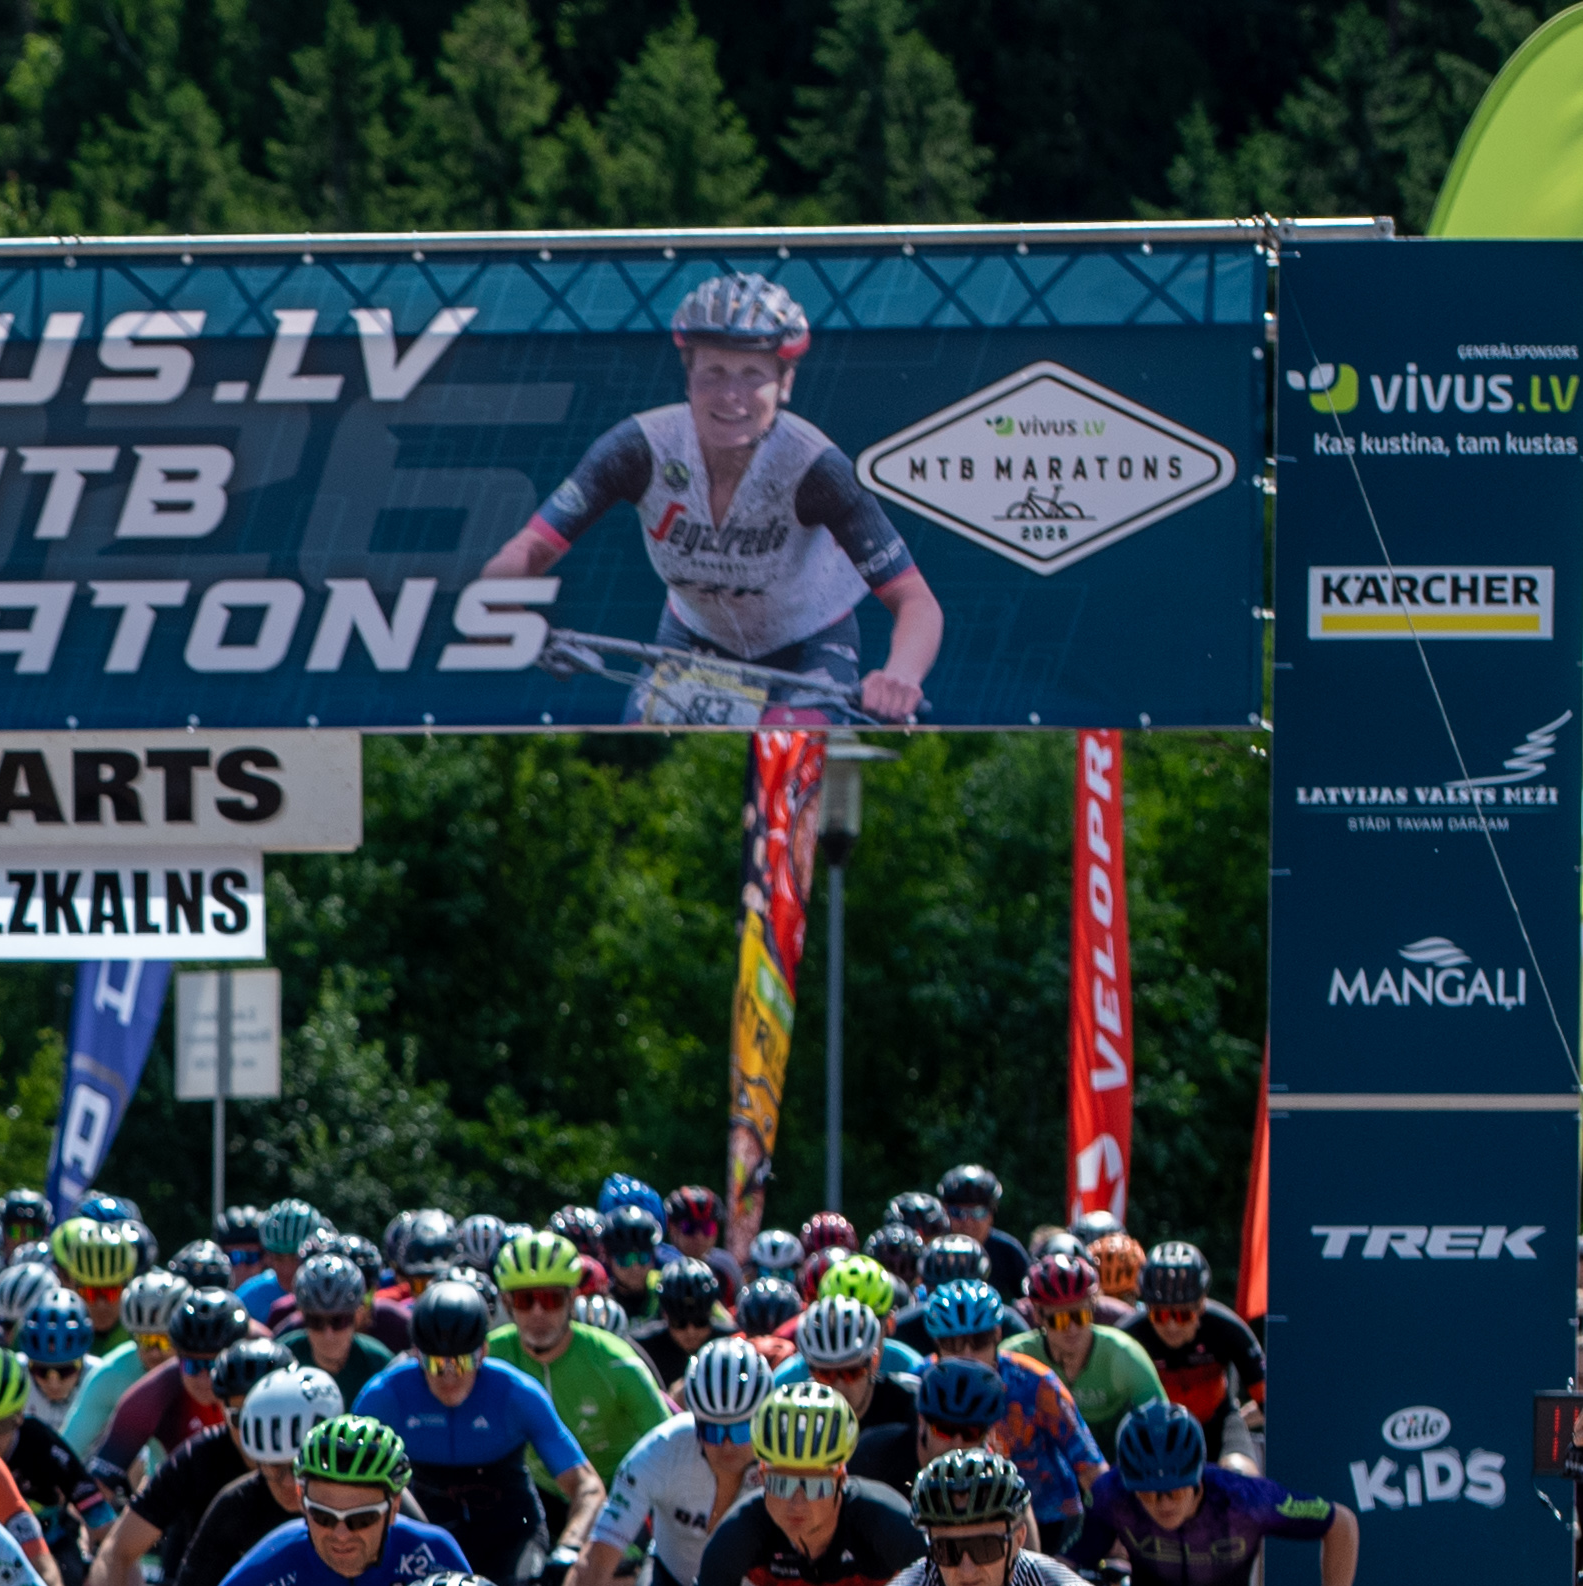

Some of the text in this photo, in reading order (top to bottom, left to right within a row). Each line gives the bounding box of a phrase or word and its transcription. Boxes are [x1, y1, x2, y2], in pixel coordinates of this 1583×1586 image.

[1314, 432, 1355, 455] Kas
[1457, 433, 1499, 454] tam
[1506, 431, 1578, 454] kustas
[910, 454, 1183, 481] MTB MARATONS
[1321, 573, 1540, 606] KÄRCHER
[1297, 784, 1559, 805] LATVIJAS VALSTS MEŽI
[1397, 817, 1444, 831] TAVAM
[1084, 730, 1129, 1092] VELOPR
[1328, 968, 1526, 1010] MANGAĻI
[1310, 1225, 1546, 1258] TREK
[1125, 1528, 1245, 1563] VELO
